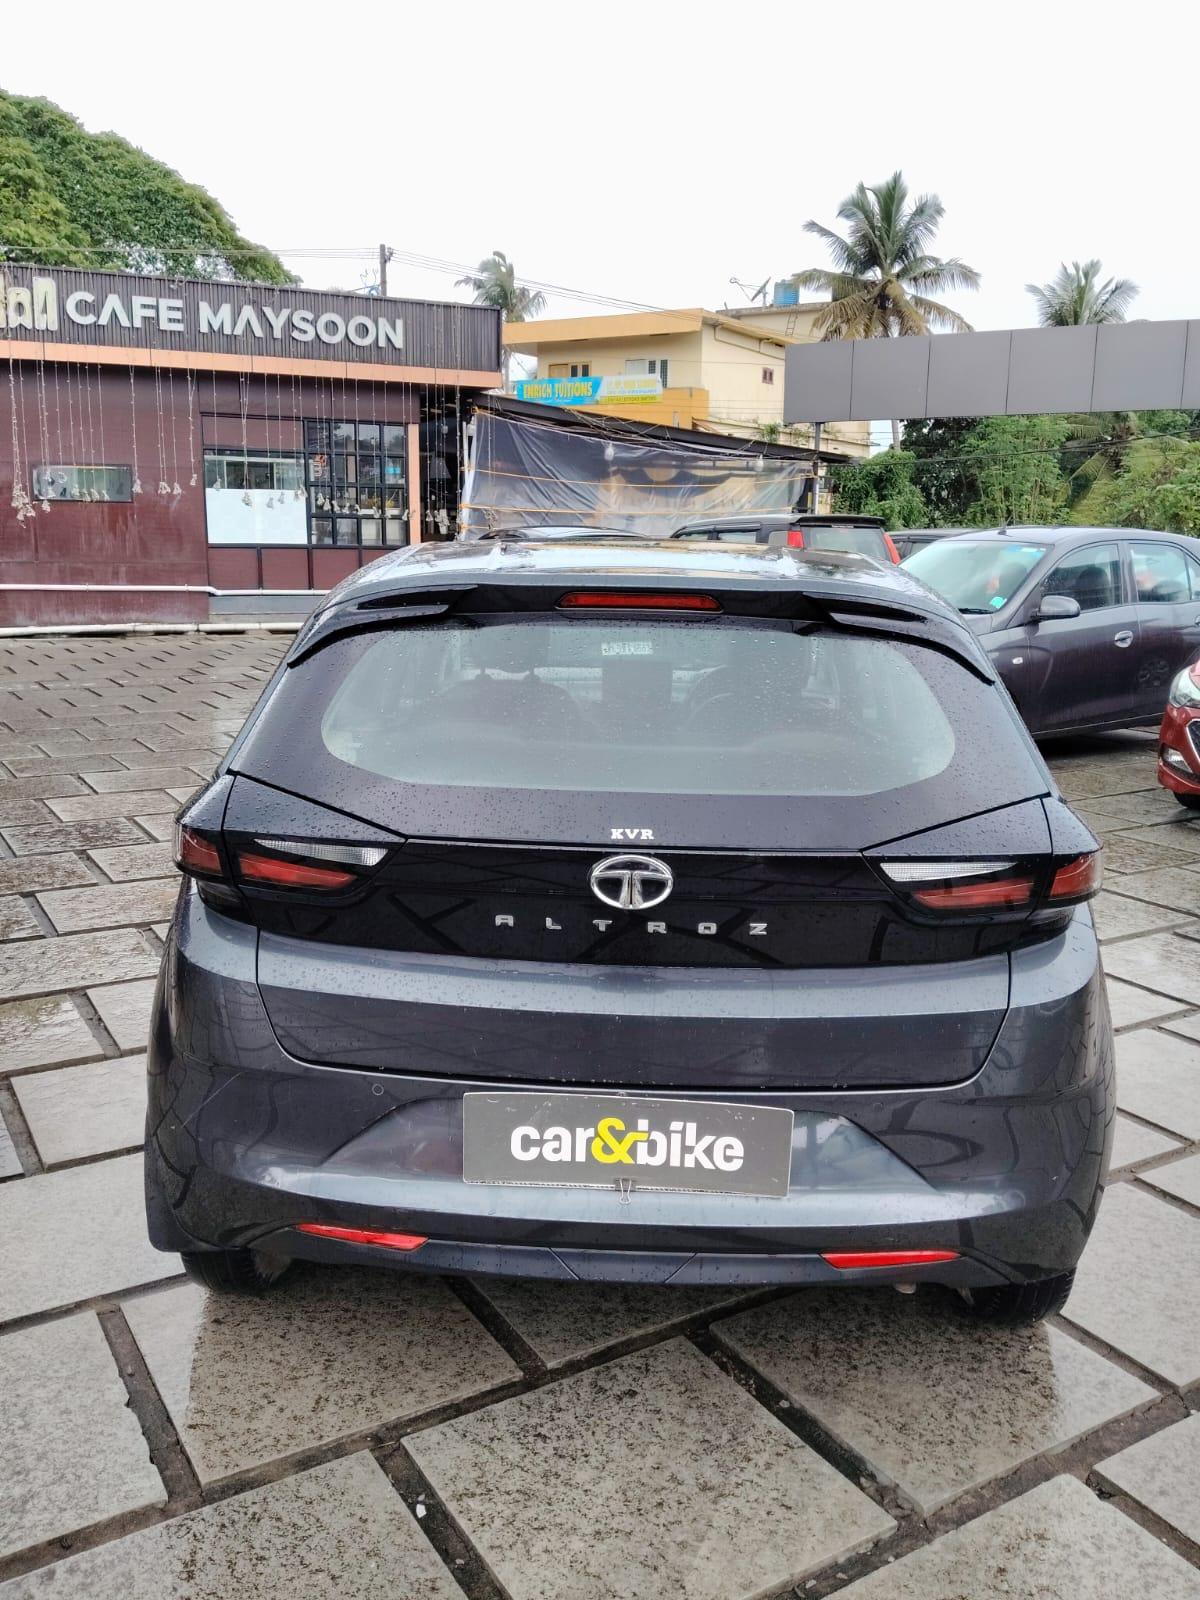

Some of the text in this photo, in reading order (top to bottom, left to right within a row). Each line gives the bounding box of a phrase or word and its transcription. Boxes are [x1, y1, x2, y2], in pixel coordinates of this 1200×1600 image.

[65, 290, 185, 332] CAFE
[199, 301, 404, 349] MAYSOON
[610, 828, 655, 840] KVR
[495, 914, 768, 936] ALTROZ
[510, 1117, 745, 1172] car&bike
